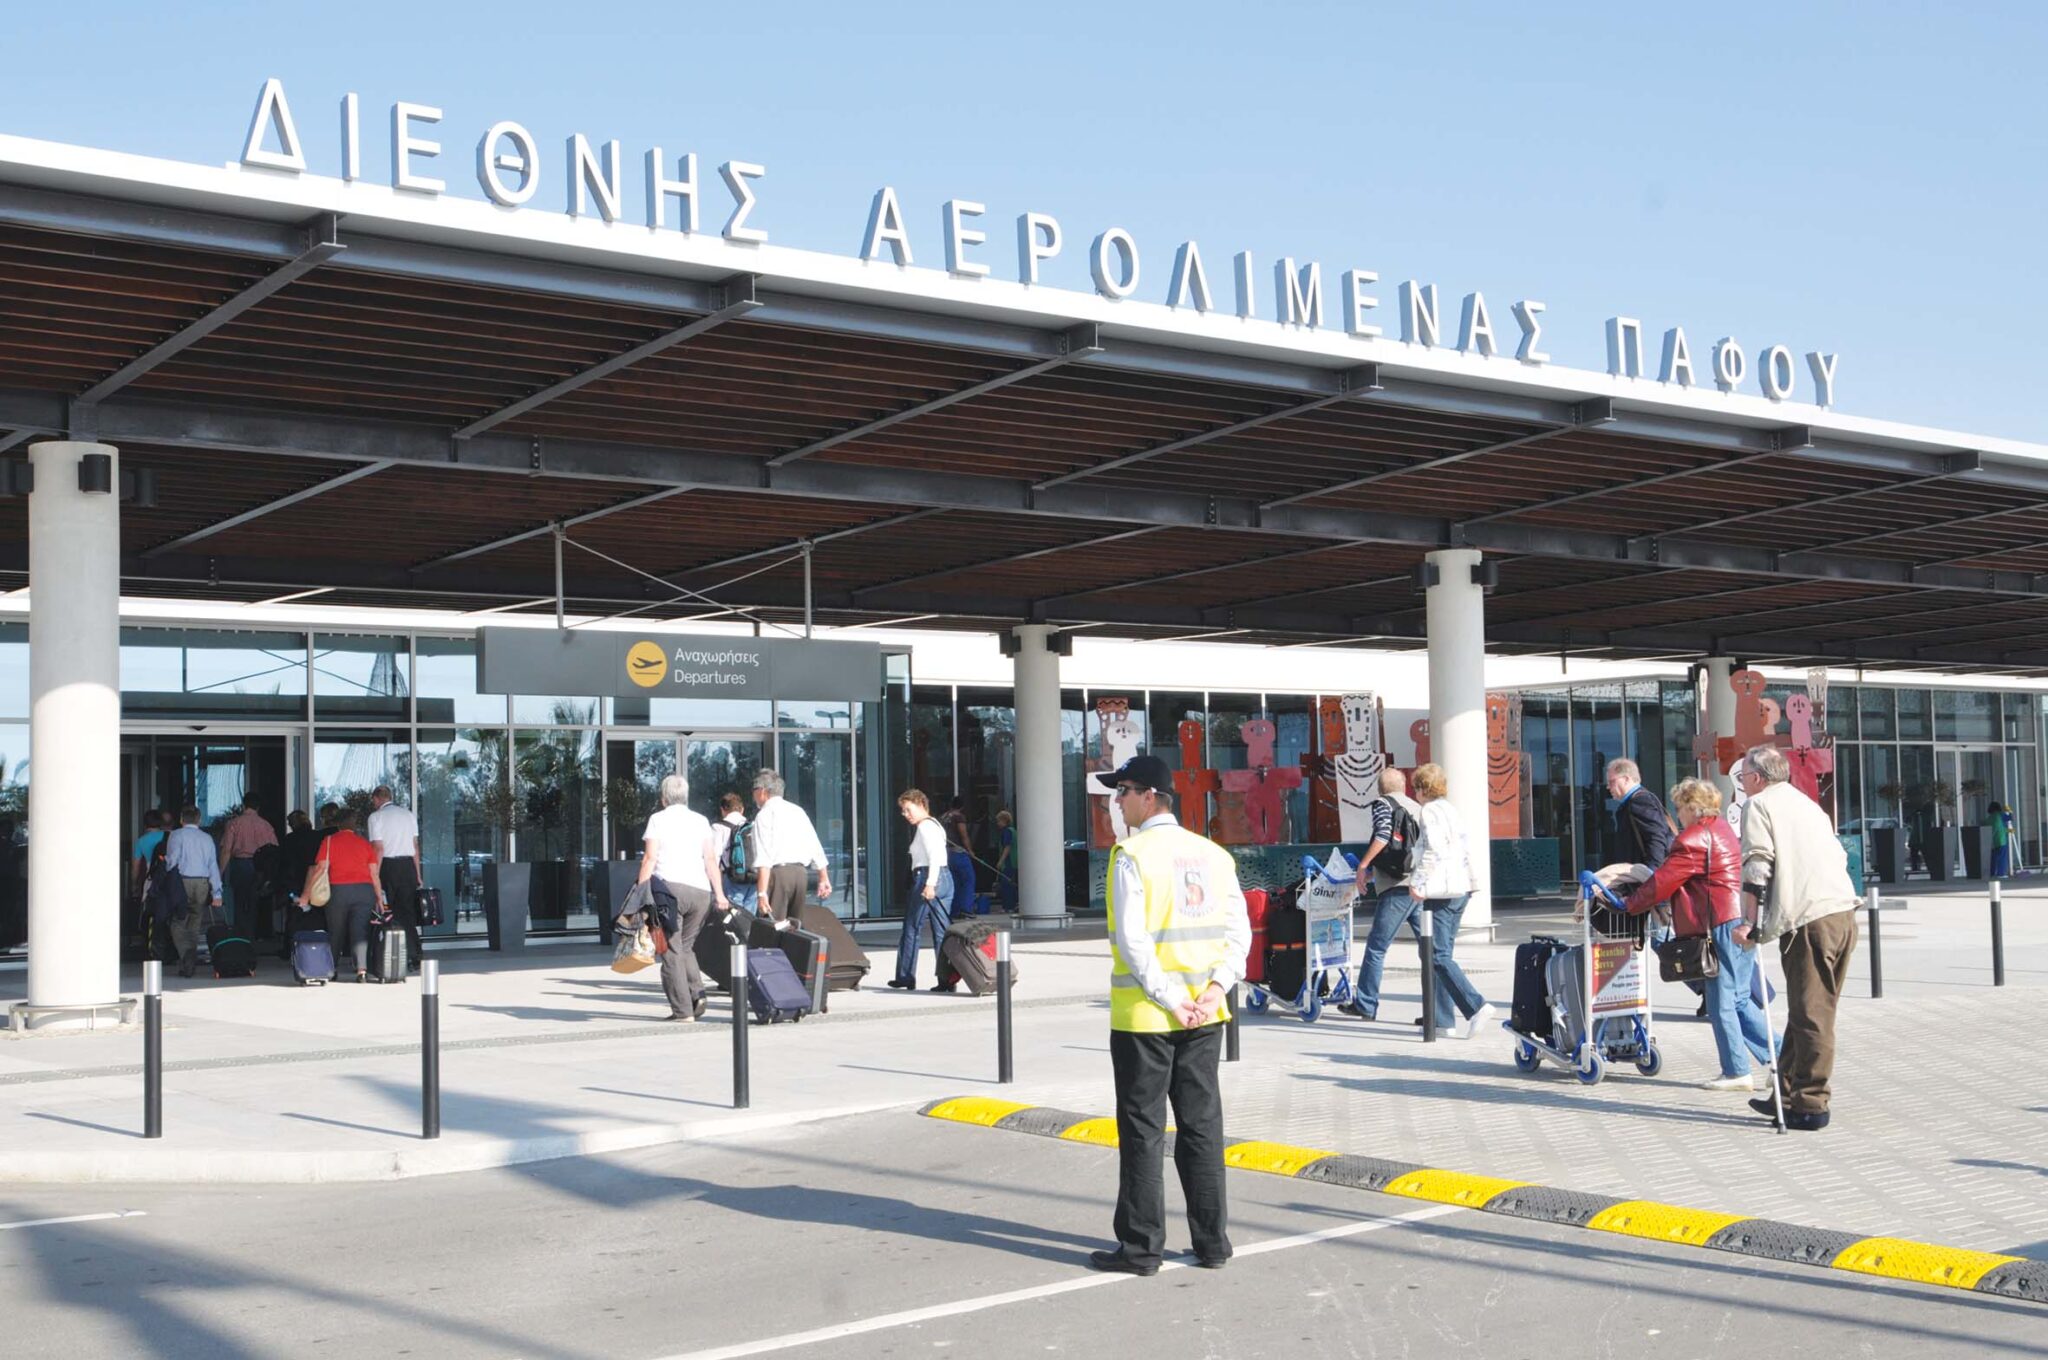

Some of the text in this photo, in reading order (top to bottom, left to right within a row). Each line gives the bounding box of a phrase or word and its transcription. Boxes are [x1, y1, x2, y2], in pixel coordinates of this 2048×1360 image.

[240, 78, 1839, 409] ΔΙΕΘΝΗΣ ΑΕΡΟΛΙΜΕΝΑΣ ΠΑΦΟΥ
[674, 647, 760, 667] Αναχωρήσεις
[674, 669, 746, 686] Departures
